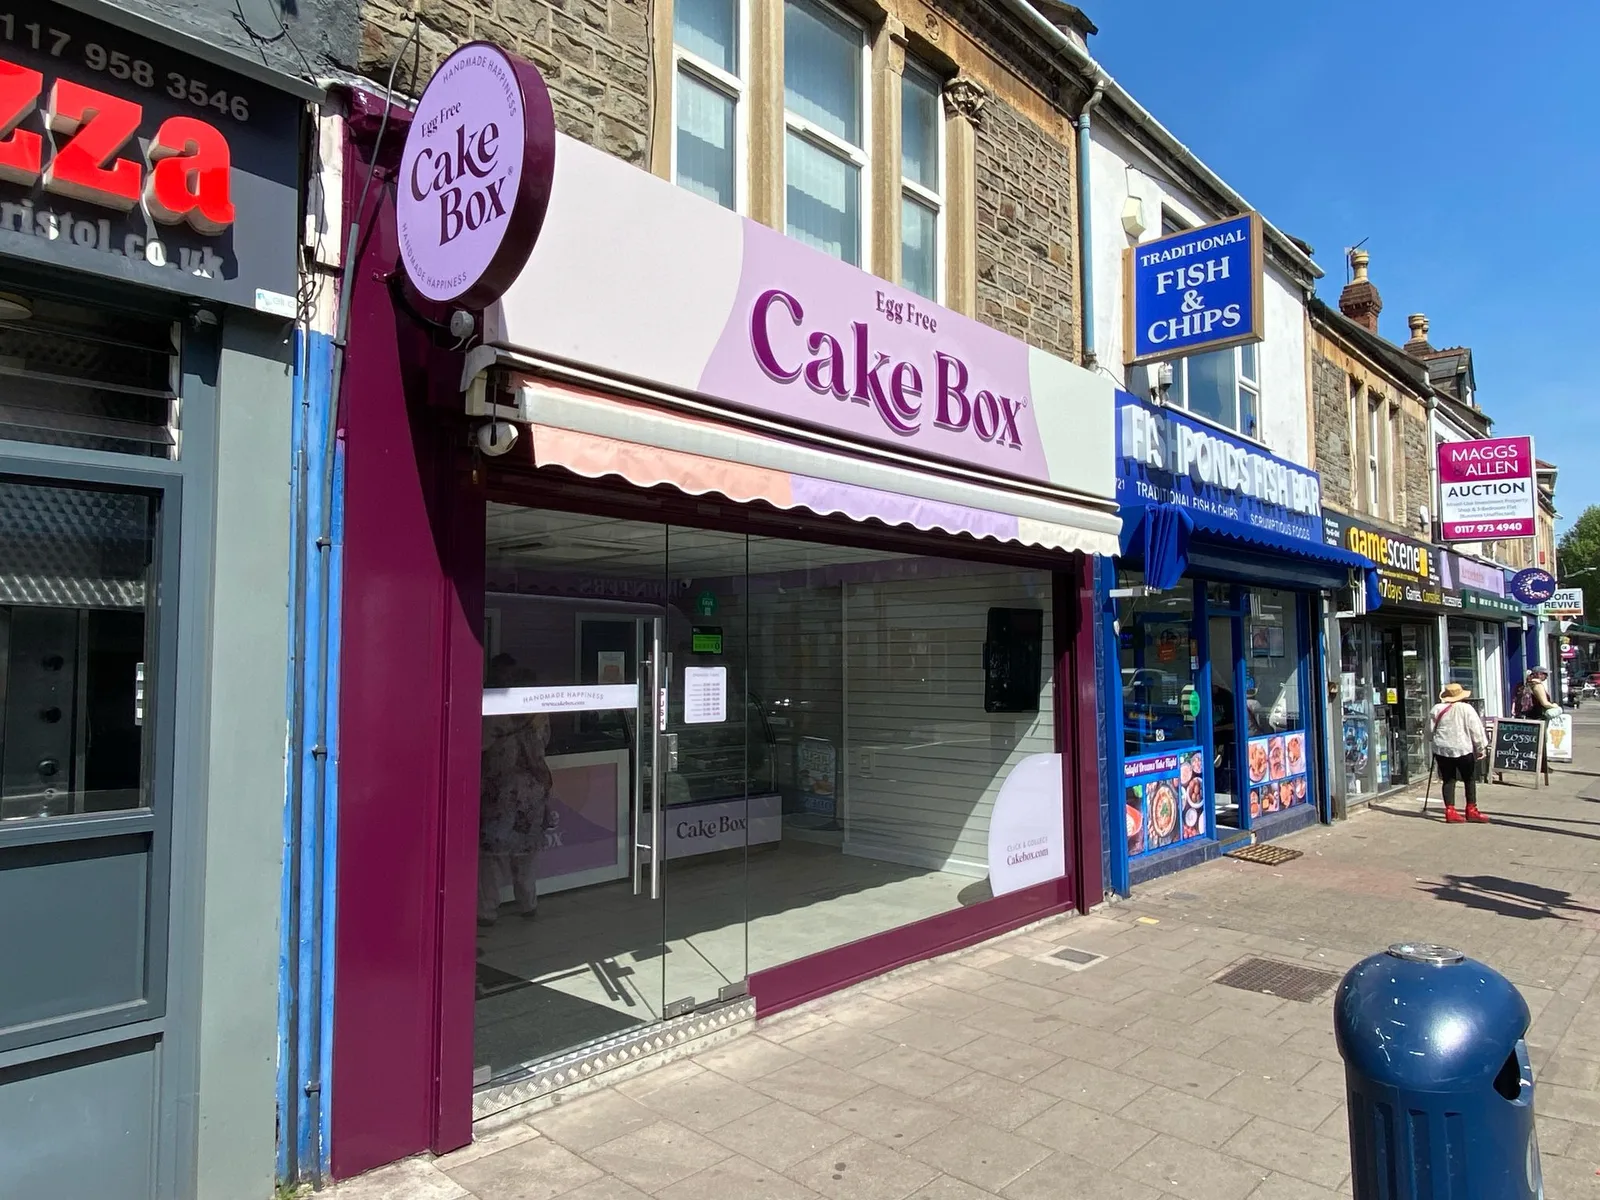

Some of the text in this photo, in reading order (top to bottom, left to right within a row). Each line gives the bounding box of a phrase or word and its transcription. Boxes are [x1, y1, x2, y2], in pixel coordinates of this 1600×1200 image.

[85, 42, 155, 88] 958
[166, 72, 250, 122] 3546
[443, 56, 517, 117] HANDMADE HAPPINESS
[420, 102, 461, 138] Egg Free
[411, 122, 500, 202] Cake
[439, 176, 507, 246] Box
[402, 222, 467, 289] HANDMADE HAPPINESS
[1141, 230, 1246, 267] TRADITIONAL
[1156, 256, 1230, 295] FISH
[875, 290, 937, 333] Egg Free
[1181, 289, 1205, 313] &
[1147, 304, 1241, 344] CHIPS
[750, 289, 1024, 451] Cake Box
[1122, 404, 1321, 517] FISHPONDS FISH BAR
[1452, 445, 1518, 462] MAGGS
[1465, 460, 1519, 477] ALLEN
[1136, 481, 1239, 521] TRADITIONAL FISH & CHIPS
[1448, 482, 1525, 498] AUCTION
[1454, 522, 1523, 534] 0117 973 4940
[1387, 580, 1403, 604] days
[1544, 601, 1580, 609] REVIVE
[523, 691, 604, 703] HANDMADE HAPPINESS
[676, 815, 746, 839] Cake Box
[1006, 848, 1049, 866] Cakebox.com
